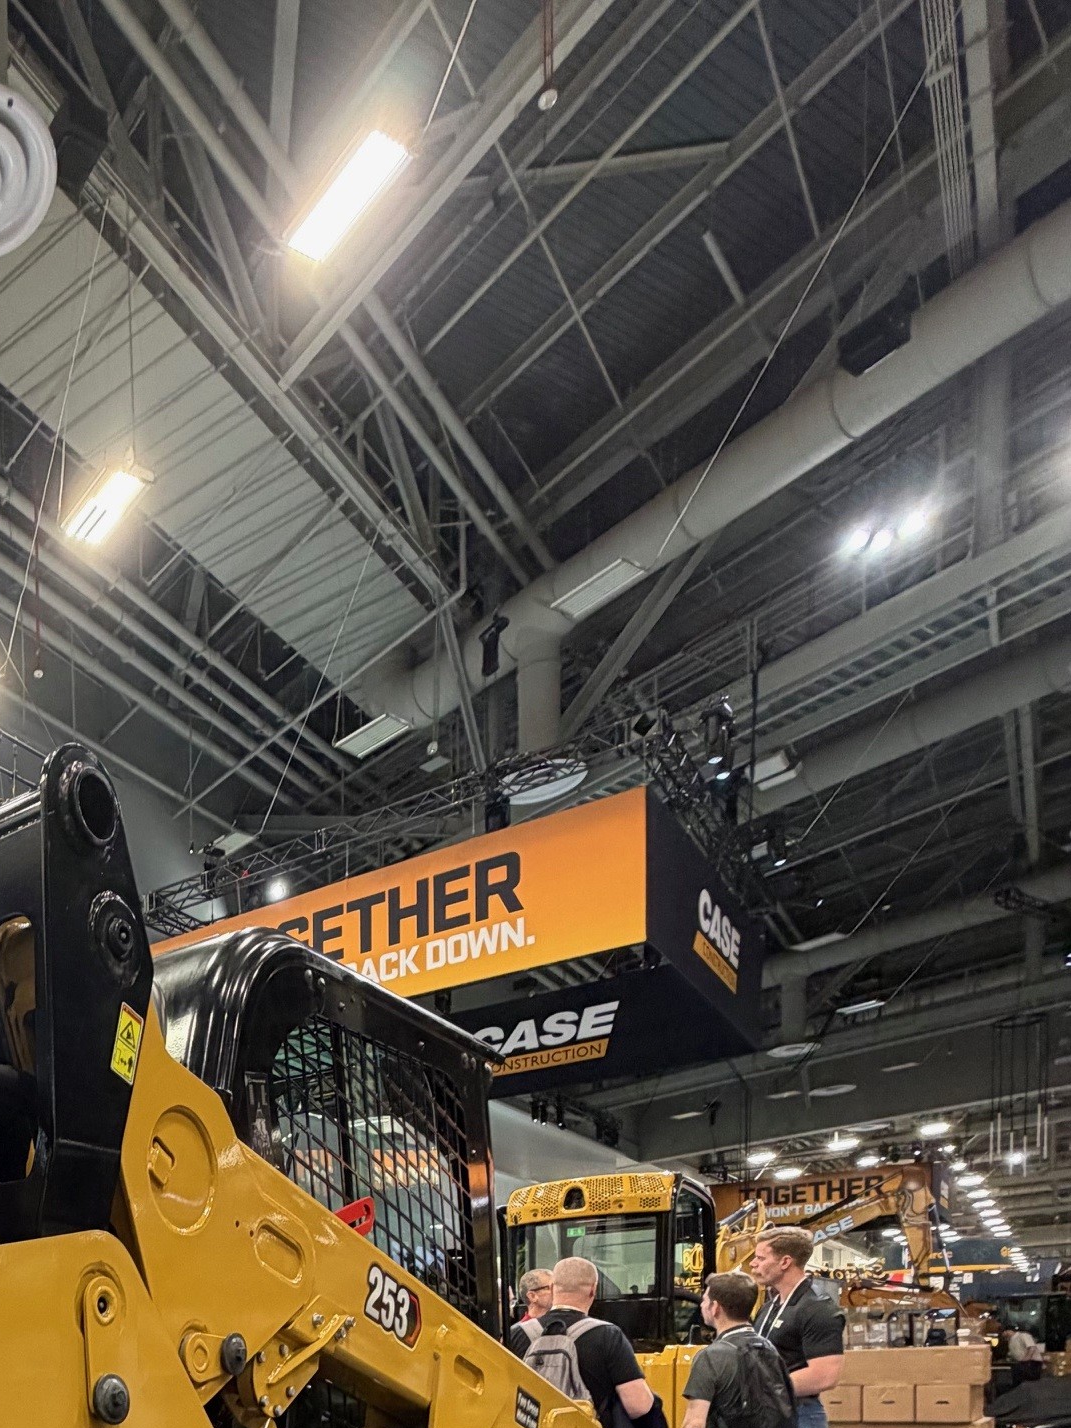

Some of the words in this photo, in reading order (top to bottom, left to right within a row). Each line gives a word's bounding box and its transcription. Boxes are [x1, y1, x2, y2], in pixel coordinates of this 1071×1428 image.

[426, 917, 535, 971] DOWN.
[697, 888, 741, 970] CASE
[473, 1000, 620, 1057] CASE
[365, 1266, 410, 1338] 253
